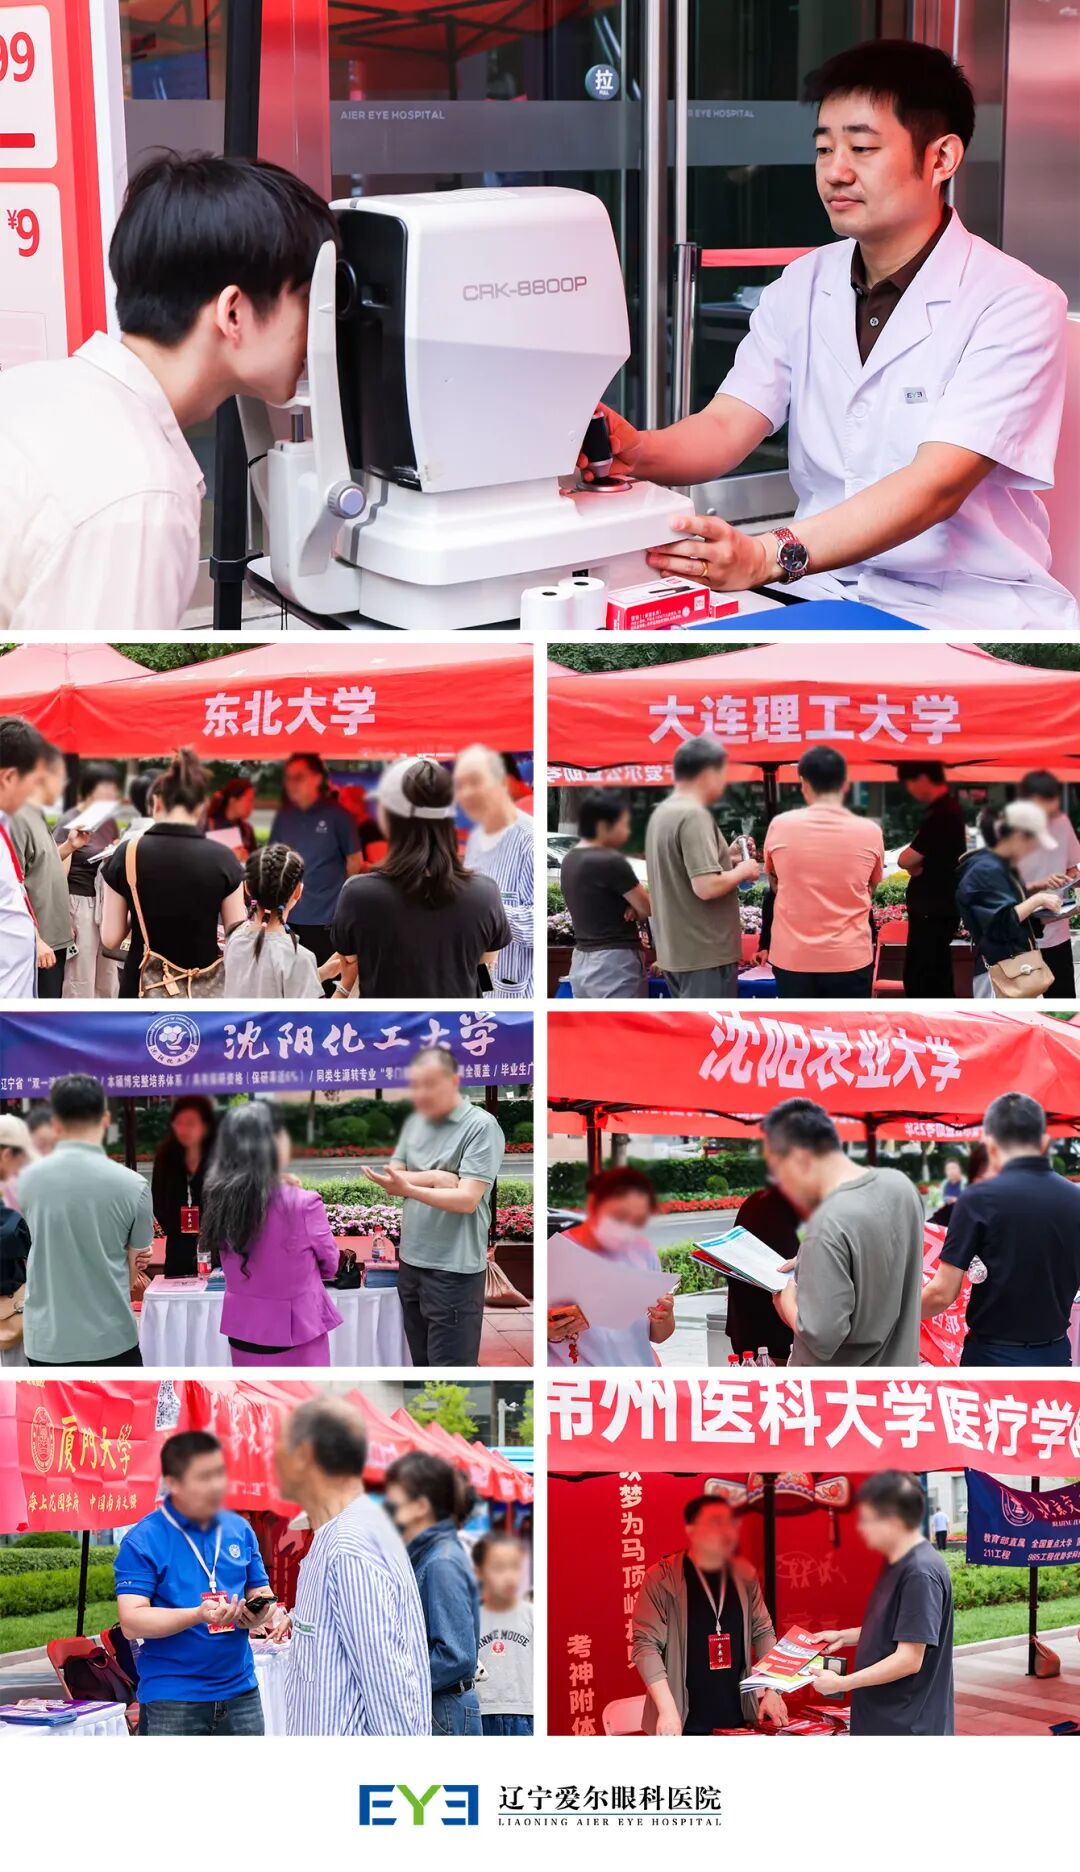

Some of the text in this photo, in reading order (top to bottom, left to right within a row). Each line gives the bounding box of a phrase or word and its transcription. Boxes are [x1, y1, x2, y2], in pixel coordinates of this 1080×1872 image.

[595, 69, 614, 90] 拉
[340, 110, 445, 120] AIER EYE HOSPITAL
[695, 109, 712, 118] EYE
[713, 109, 755, 118] HOSPITAL
[462, 276, 588, 301] CRK-8800P
[202, 685, 377, 738] 东北大学
[649, 694, 961, 745] 大连理工大学
[223, 1011, 498, 1060] 沈阳化工大学
[698, 1012, 962, 1093] 沈阳农业大学
[547, 1381, 1080, 1460] 州医科大学医疗学
[983, 1532, 1026, 1548] 教育部直属
[983, 1548, 1011, 1560] 211工程
[500, 1629, 529, 1647] MOUSE
[566, 1634, 597, 1734] 考神附体
